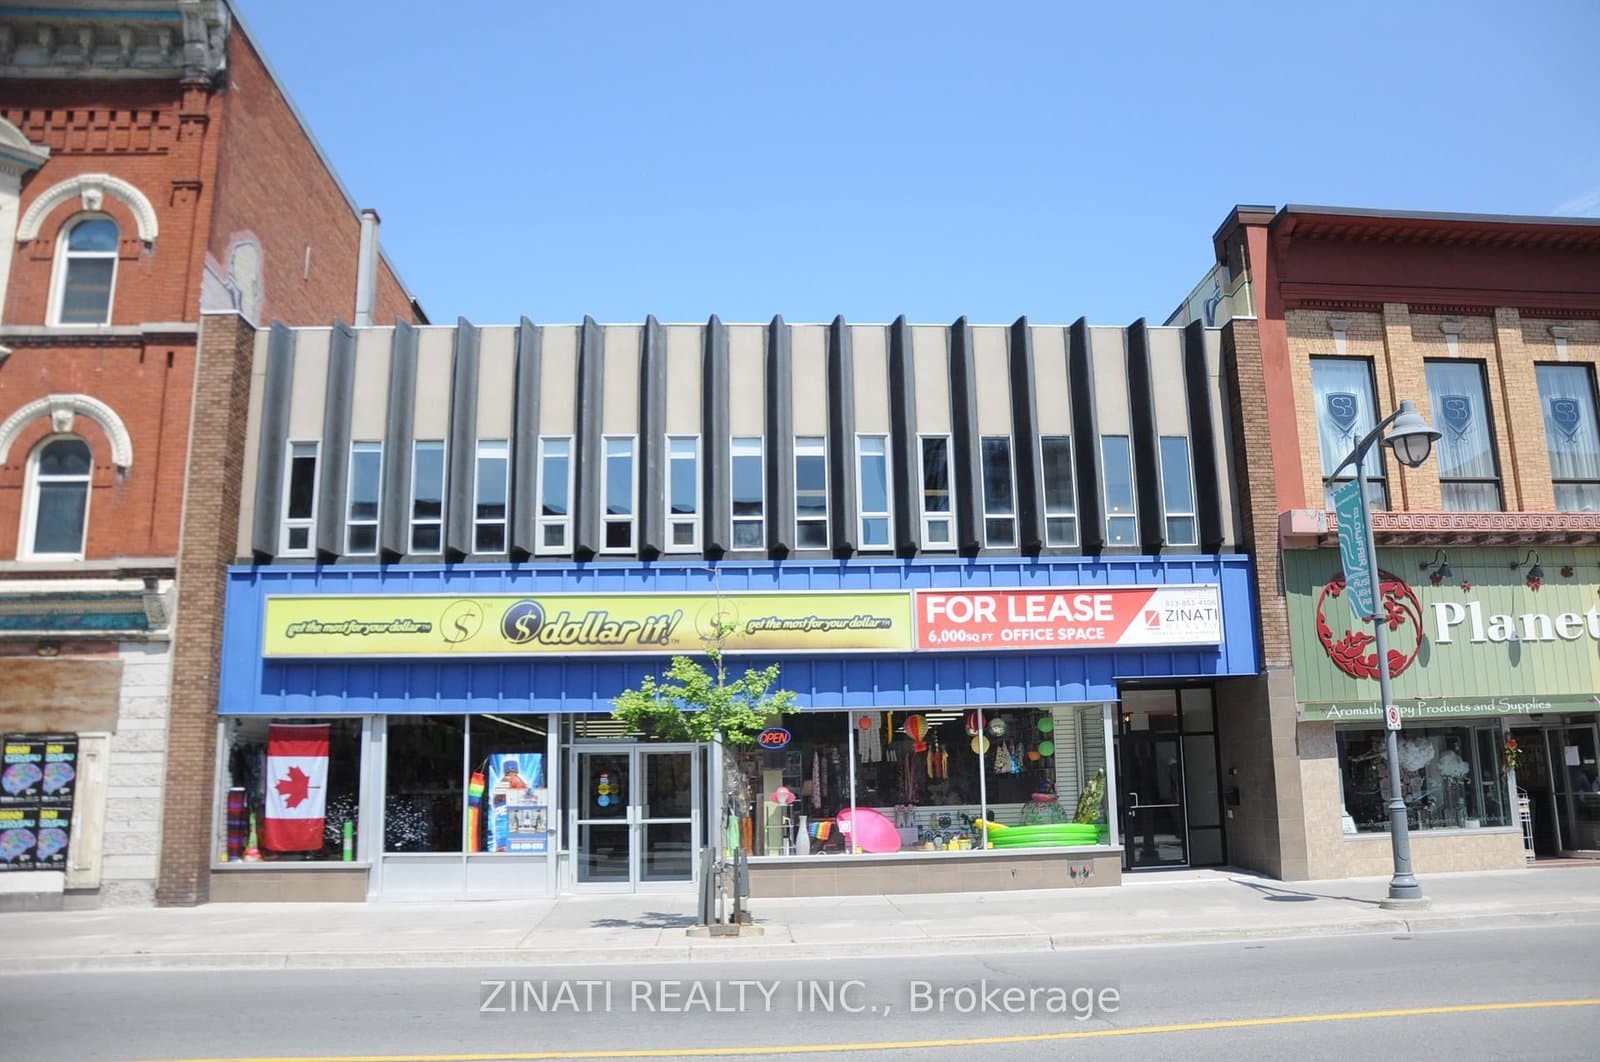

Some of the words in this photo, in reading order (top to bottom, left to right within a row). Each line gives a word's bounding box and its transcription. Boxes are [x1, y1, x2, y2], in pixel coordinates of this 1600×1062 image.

[926, 594, 998, 624] FOR
[1007, 593, 1114, 623] LEASE
[1165, 608, 1218, 622] ZINATI
[539, 611, 641, 645] dollar
[637, 609, 683, 646] it!
[746, 618, 766, 634] get
[764, 616, 782, 630] the
[782, 617, 808, 631] most
[820, 618, 850, 632] your
[848, 615, 880, 629] dollar
[1431, 600, 1600, 643] Planet
[1000, 627, 1054, 641] OFFICE
[1057, 627, 1105, 641] SPACE
[1327, 702, 1414, 719] Aromathpy
[1417, 699, 1473, 717] Products
[1473, 698, 1496, 712] and
[1497, 695, 1552, 713] Supplies
[760, 732, 788, 743] OPEN
